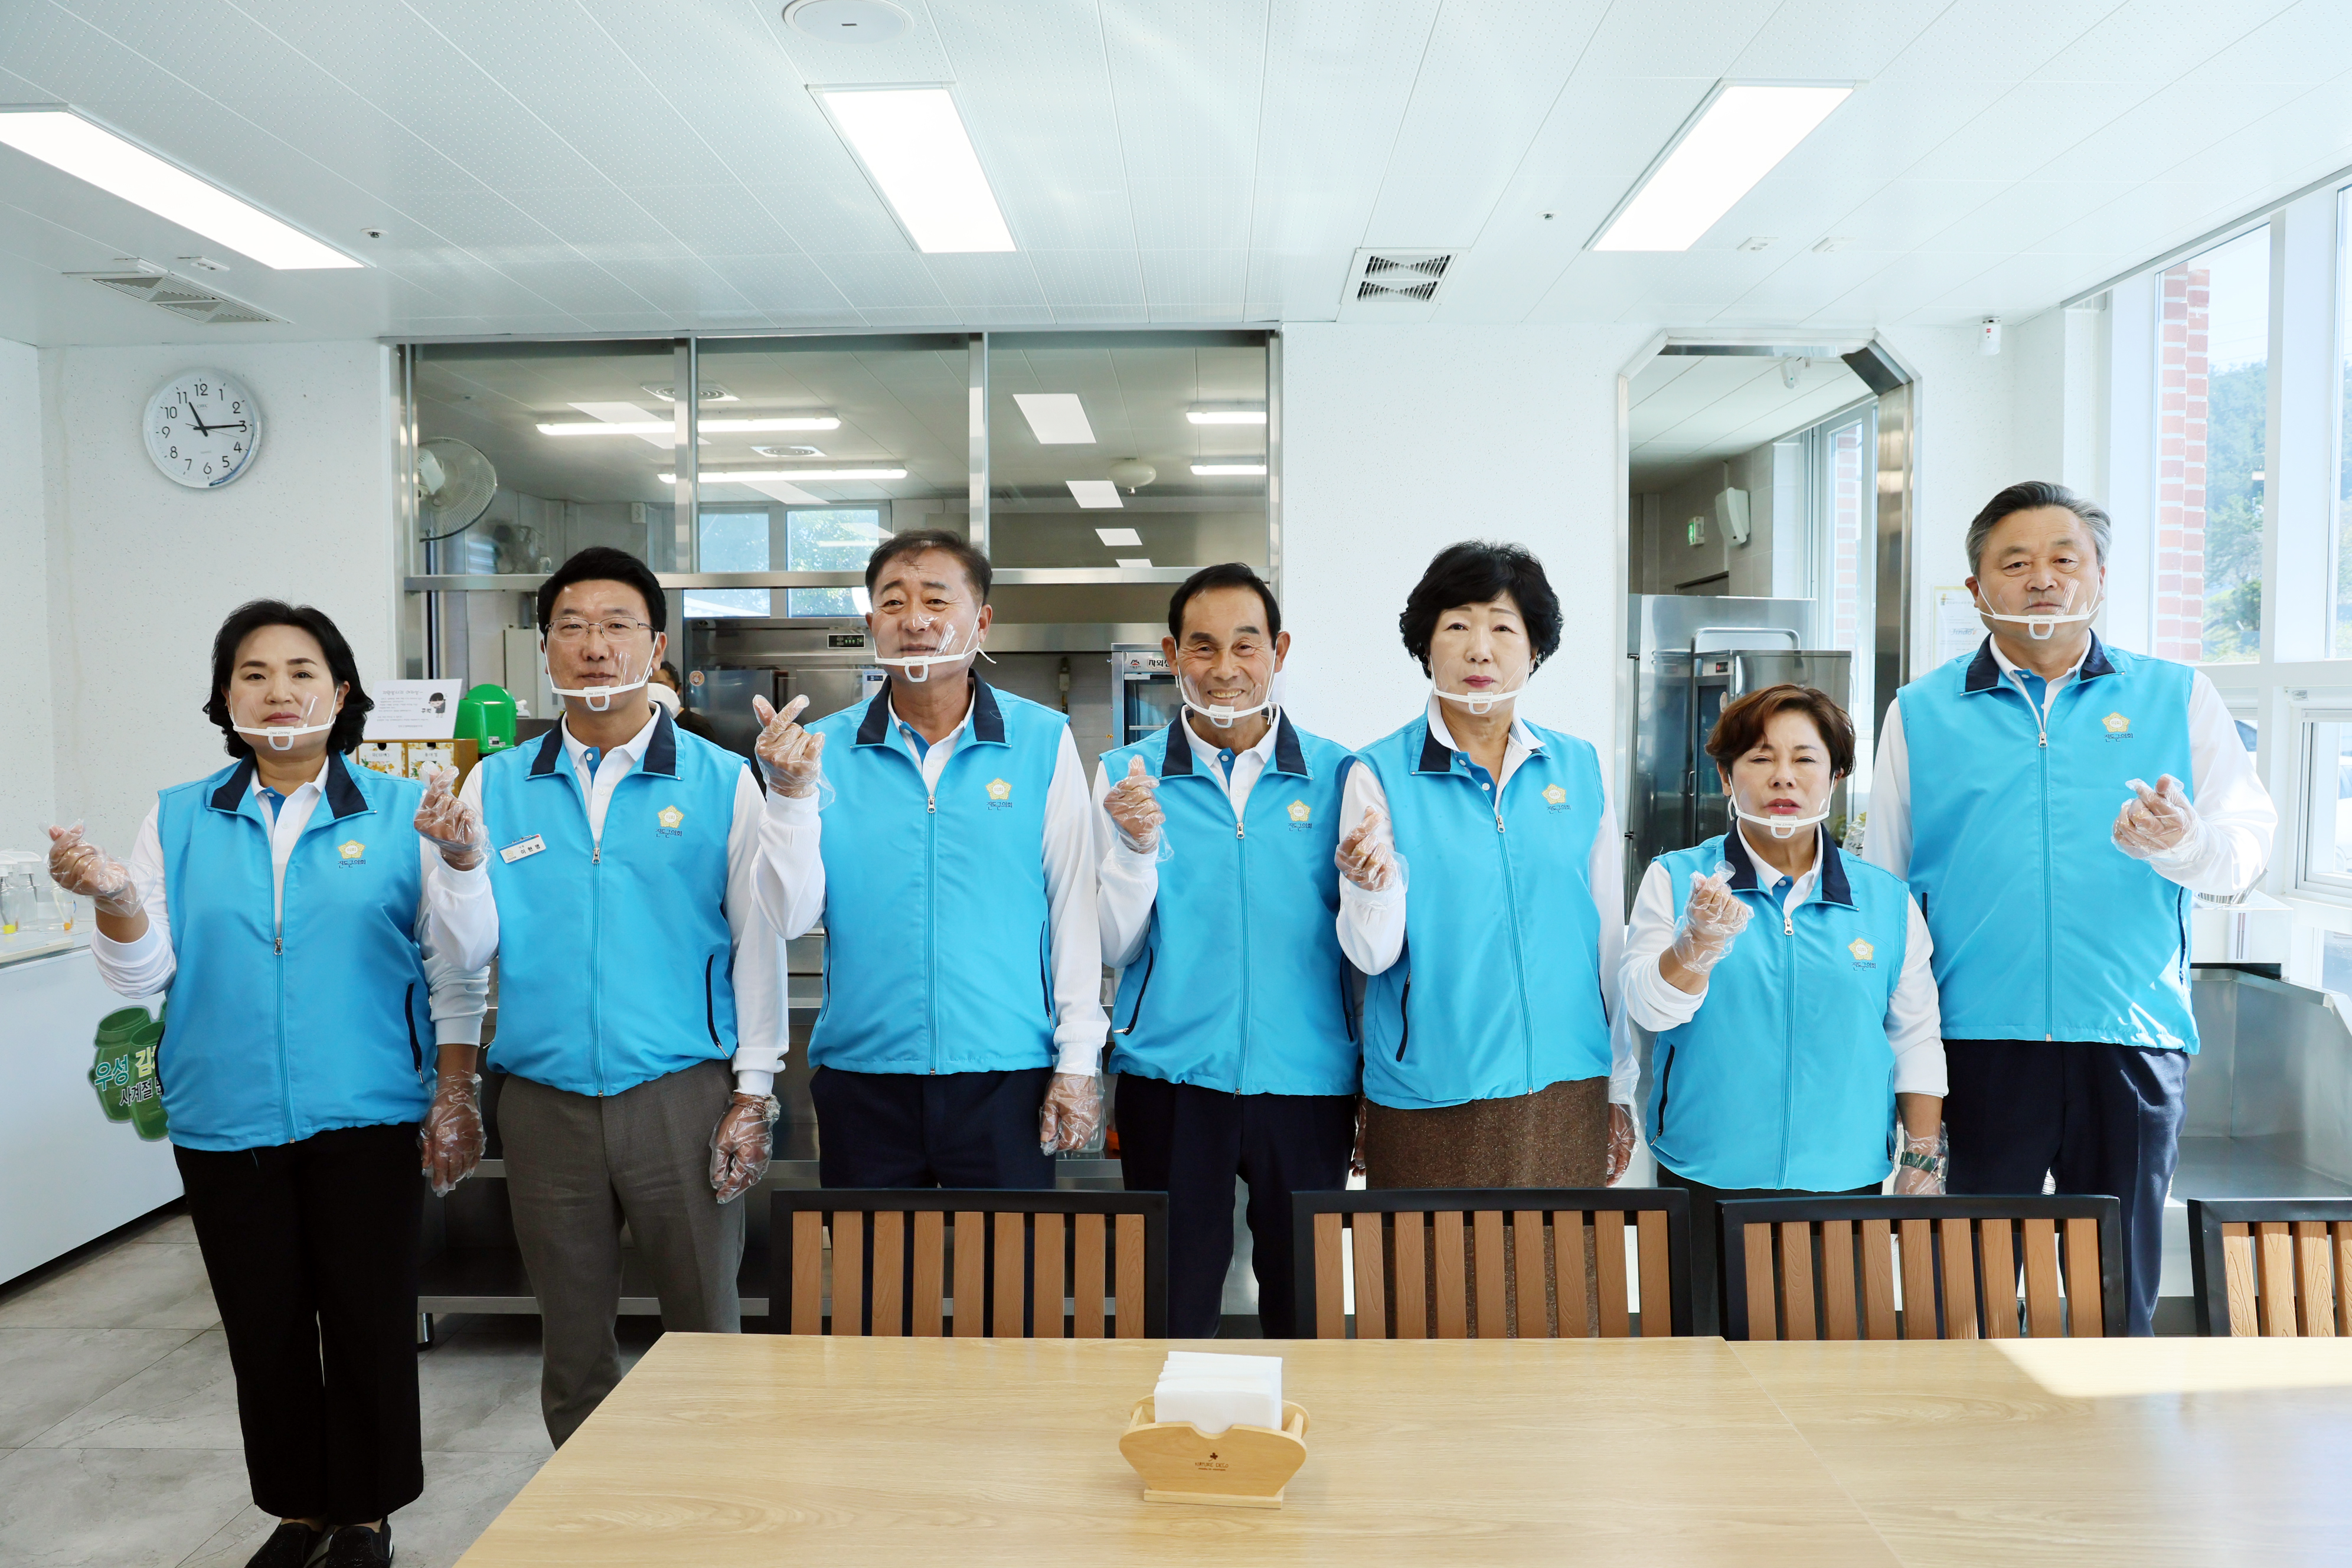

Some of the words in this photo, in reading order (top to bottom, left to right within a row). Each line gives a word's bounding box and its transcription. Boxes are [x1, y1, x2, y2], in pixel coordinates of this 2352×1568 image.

[194, 384, 208, 396] 12
[219, 388, 223, 401] 1
[177, 392, 188, 404] 11
[165, 407, 177, 419] 10
[232, 401, 241, 414] 2
[239, 420, 247, 432] 3
[162, 426, 170, 439] 9
[170, 446, 178, 459] 8
[234, 442, 242, 453] 4
[185, 459, 192, 471] 7
[203, 462, 212, 474] 6
[222, 456, 230, 468] 5
[2103, 733, 2134, 743] 진도군의회
[986, 801, 1012, 811] 진도군의회
[1547, 804, 1571, 814] 진도군의회
[1288, 822, 1312, 831] 진도군의회
[655, 828, 682, 838] 진도군의회
[337, 859, 366, 868] 진도군의회
[1851, 962, 1876, 971] 진도군의회
[94, 1054, 129, 1092] 우성
[119, 1078, 153, 1106] 사계절
